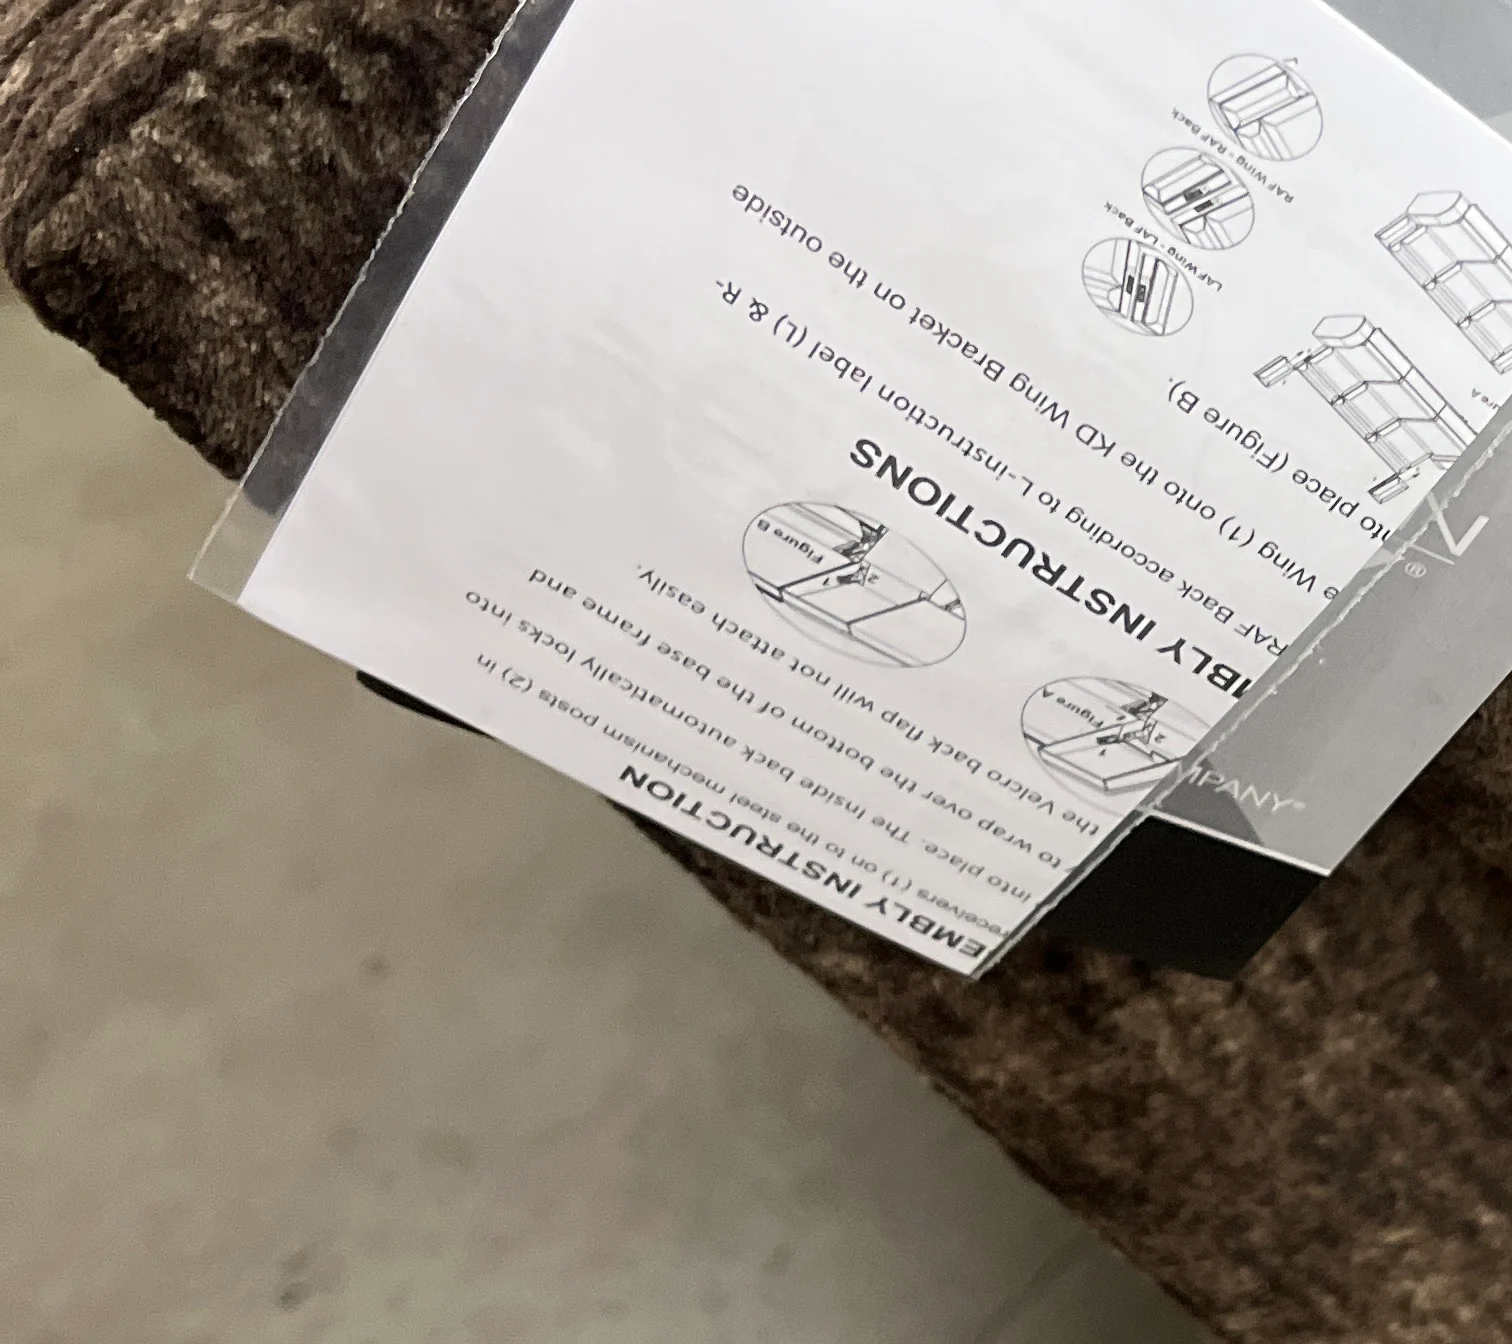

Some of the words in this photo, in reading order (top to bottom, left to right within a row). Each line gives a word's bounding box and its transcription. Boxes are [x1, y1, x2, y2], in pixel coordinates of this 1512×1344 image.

[1171, 107, 1201, 135] Back
[1200, 134, 1227, 154] RAF
[1235, 155, 1266, 185] Wing
[1266, 183, 1294, 203] RAF
[732, 184, 822, 252] outside
[1103, 200, 1134, 228] Back
[1133, 226, 1158, 247] LAF
[828, 251, 867, 288] the
[1166, 246, 1197, 274] Wing
[715, 280, 742, 305] R-
[873, 281, 905, 310] on
[1197, 273, 1222, 292] LAF
[748, 296, 769, 322] &
[772, 313, 807, 348] (L)
[908, 306, 1005, 382] Bracket
[807, 340, 872, 392] label
[1008, 372, 1069, 429] Wing
[1167, 377, 1200, 414] B).
[877, 383, 1034, 497] L-instruction
[1075, 423, 1116, 457] KD
[1203, 407, 1288, 473] (Figure
[1120, 451, 1158, 485] the
[1038, 490, 1061, 513] to
[1163, 480, 1216, 520] onto
[1292, 468, 1360, 518] place
[773, 528, 824, 564] Figure
[849, 438, 1156, 641] INSTRUCTIONS
[1064, 505, 1174, 582] according
[1218, 515, 1255, 547] (1)
[527, 568, 577, 599] and
[1257, 540, 1316, 593] Wing
[637, 564, 705, 614] easily.
[1176, 579, 1234, 624] Back
[465, 591, 512, 626] into
[581, 596, 651, 646] frame
[518, 619, 576, 662] locks
[711, 612, 785, 660] attach
[1233, 623, 1294, 657] RAF
[477, 653, 497, 673] in
[656, 641, 711, 681] base
[788, 657, 831, 686] not
[501, 666, 533, 693] (2)
[716, 676, 755, 705] the
[538, 689, 599, 726] posts
[579, 656, 736, 747] automatically
[755, 701, 785, 718] of
[832, 683, 873, 712] will
[880, 710, 923, 741] flap
[602, 724, 725, 794] mechanism
[790, 716, 874, 770] bottom
[927, 735, 982, 774] back
[740, 745, 794, 783] back
[879, 766, 917, 793] the
[728, 792, 782, 823] steel
[920, 790, 972, 820] over
[986, 769, 1054, 815] Velcro
[618, 764, 862, 899] INSTRUCTION
[786, 822, 819, 846] the
[870, 816, 910, 843] The
[977, 818, 1032, 853] wrap
[1061, 810, 1099, 836] the
[824, 842, 845, 858] to
[851, 854, 877, 872] on
[1037, 851, 1061, 869] to
[881, 869, 912, 891] (1)
[985, 875, 1031, 903] into
